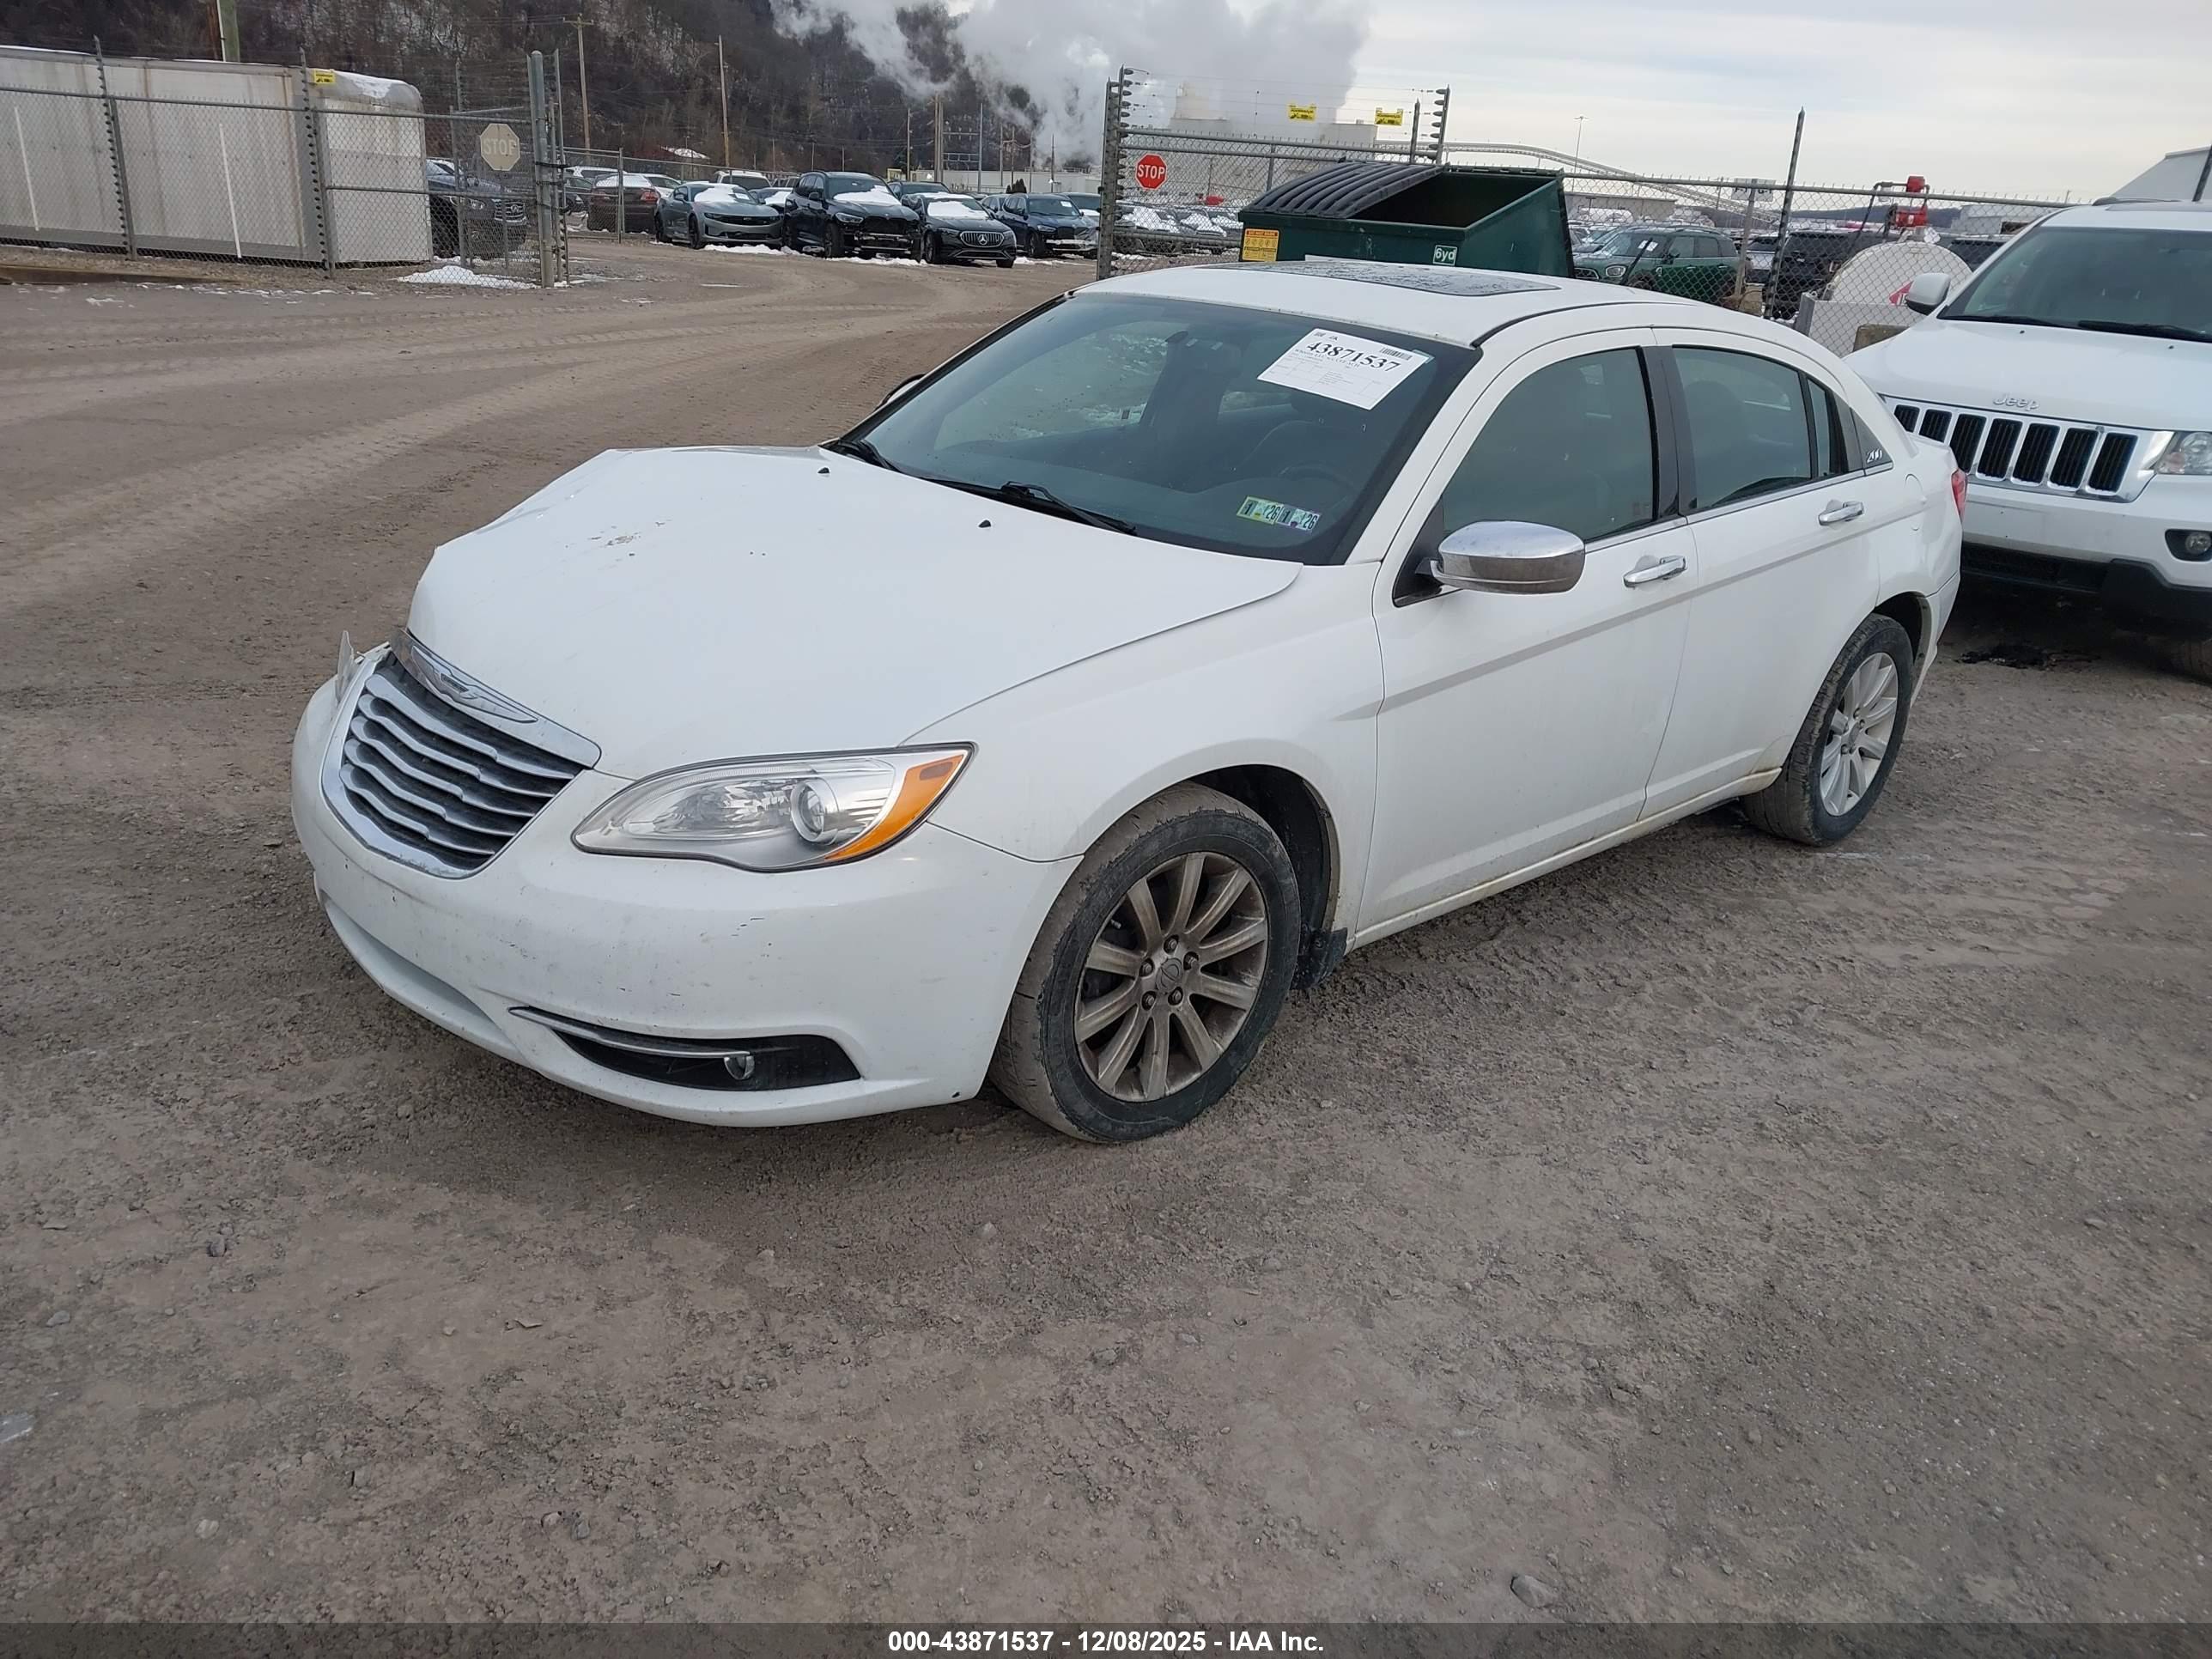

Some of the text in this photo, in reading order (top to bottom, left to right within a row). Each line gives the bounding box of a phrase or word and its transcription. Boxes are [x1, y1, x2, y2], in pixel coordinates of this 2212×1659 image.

[483, 138, 517, 155] STOP
[1138, 164, 1165, 179] STOP
[1436, 248, 1456, 262] 6yd
[1307, 342, 1401, 372] 43871537
[1992, 393, 2040, 412] Jeep
